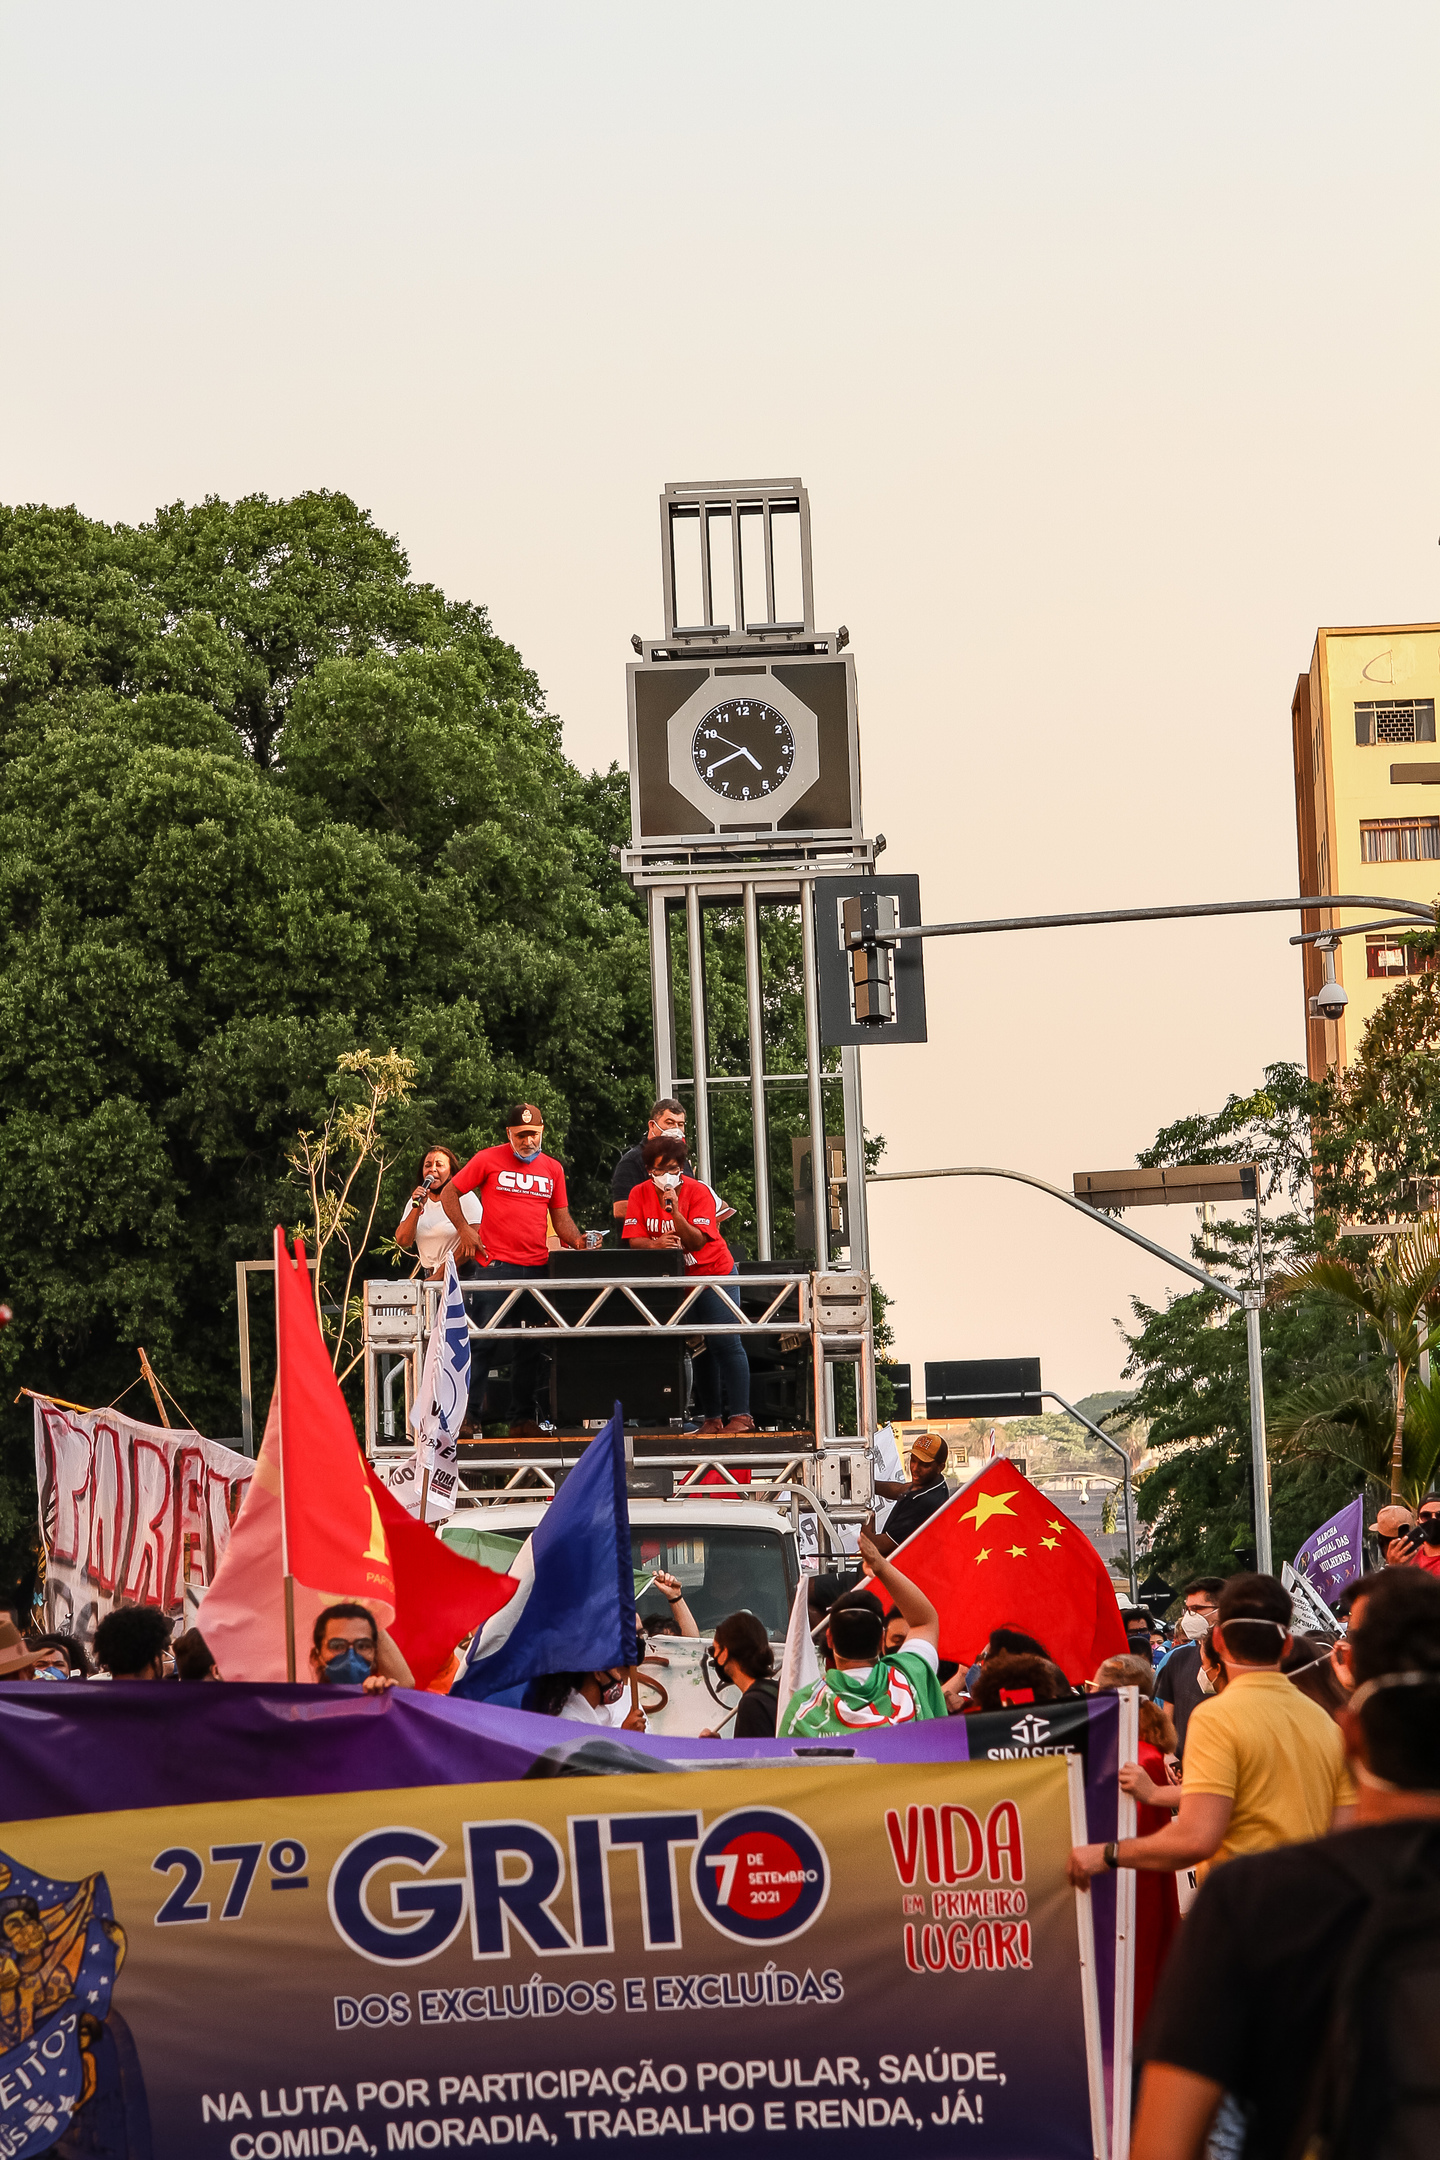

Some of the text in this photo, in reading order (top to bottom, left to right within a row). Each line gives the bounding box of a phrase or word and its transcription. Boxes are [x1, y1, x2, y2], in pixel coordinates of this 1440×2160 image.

[716, 714, 729, 723] 11
[736, 707, 749, 716] 12
[760, 711, 766, 720] 1
[704, 729, 717, 739] 10
[775, 725, 782, 734] 2
[700, 749, 707, 758] 9
[782, 745, 789, 754] 3
[706, 768, 714, 778] 8
[776, 765, 784, 775] 4
[722, 782, 729, 791] 7
[742, 786, 749, 795] 6
[762, 780, 769, 789] 5
[433, 1468, 457, 1487] FORA
[1316, 1525, 1338, 1547] MARCHA
[1312, 1534, 1350, 1562] MUNDIAL DAS
[1319, 1550, 1352, 1573] MULHERES
[884, 1799, 1026, 1887] VIDA
[704, 1853, 764, 1906] 7 DE
[748, 1869, 818, 1885] SETEMBRO
[327, 1805, 831, 1967] GRITO
[749, 1890, 780, 1905] 2021
[902, 1888, 1028, 1920] EM PRIMEIRO
[904, 1919, 1033, 1974] LUGAR!
[334, 1960, 844, 2030] DOS EXCLUÍDOS E EXCLUÍDAS
[201, 2046, 1007, 2123] NA LUTA POR PARTICIPAÇÃO POPULAR, SAÚDE,
[229, 2088, 984, 2160] COMIDA, MORADIA, TRABALHO E RENDA, JÁ!
